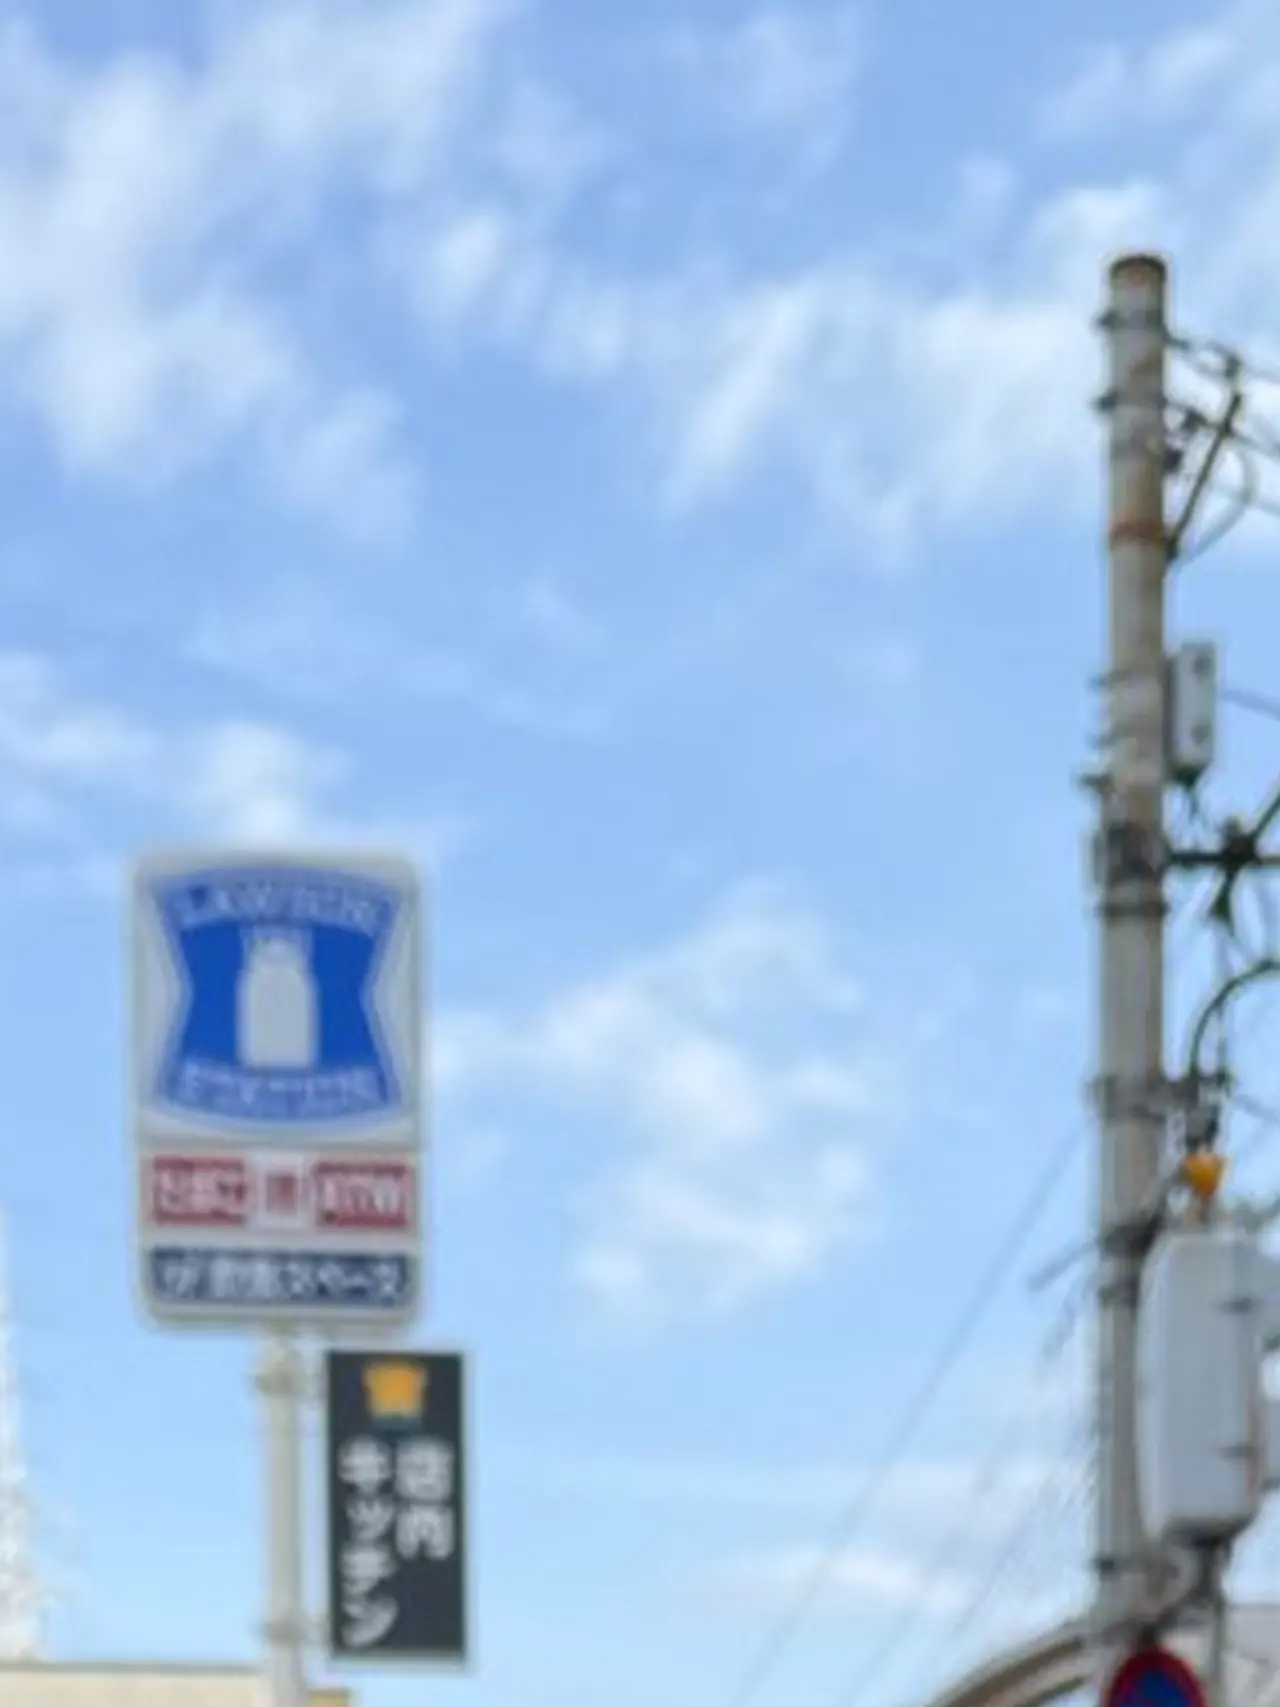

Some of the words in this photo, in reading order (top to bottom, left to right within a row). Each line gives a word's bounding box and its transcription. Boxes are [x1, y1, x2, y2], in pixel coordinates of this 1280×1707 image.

[338, 1437, 399, 1648] キッチン
[394, 1437, 454, 1560] 店内
